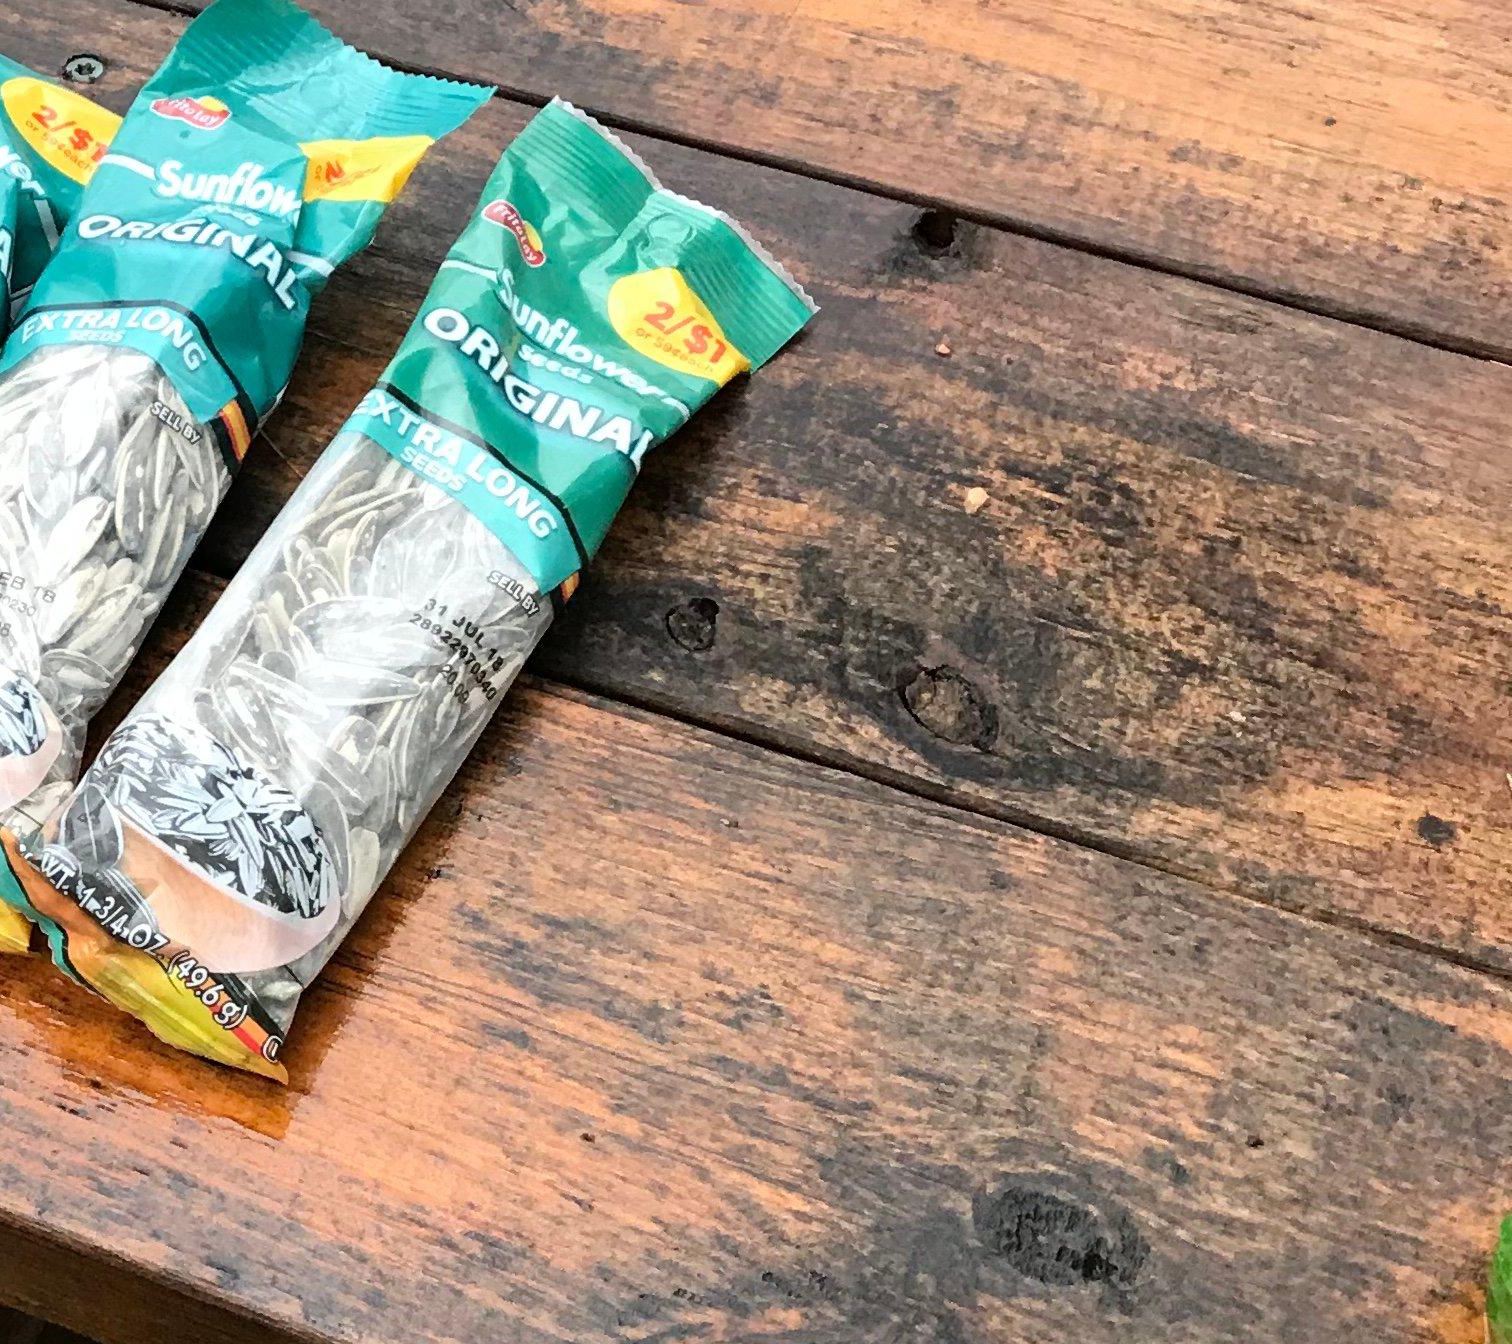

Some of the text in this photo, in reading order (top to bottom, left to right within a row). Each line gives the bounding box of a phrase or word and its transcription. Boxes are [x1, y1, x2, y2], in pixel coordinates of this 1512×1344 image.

[157, 160, 302, 216] Sunflow
[77, 214, 297, 310] ORIGINAL
[22, 306, 207, 371] EXTRA LONG
[500, 268, 668, 395] Sunflower
[643, 301, 727, 363] 2/$1
[150, 401, 202, 445] SELL BY
[353, 391, 557, 538] EXTRA LONG
[400, 445, 468, 492] SEEDS
[488, 570, 540, 618] SELL BY
[424, 598, 448, 616] 31
[452, 616, 485, 649] JUL
[167, 950, 225, 1006] (49.6
